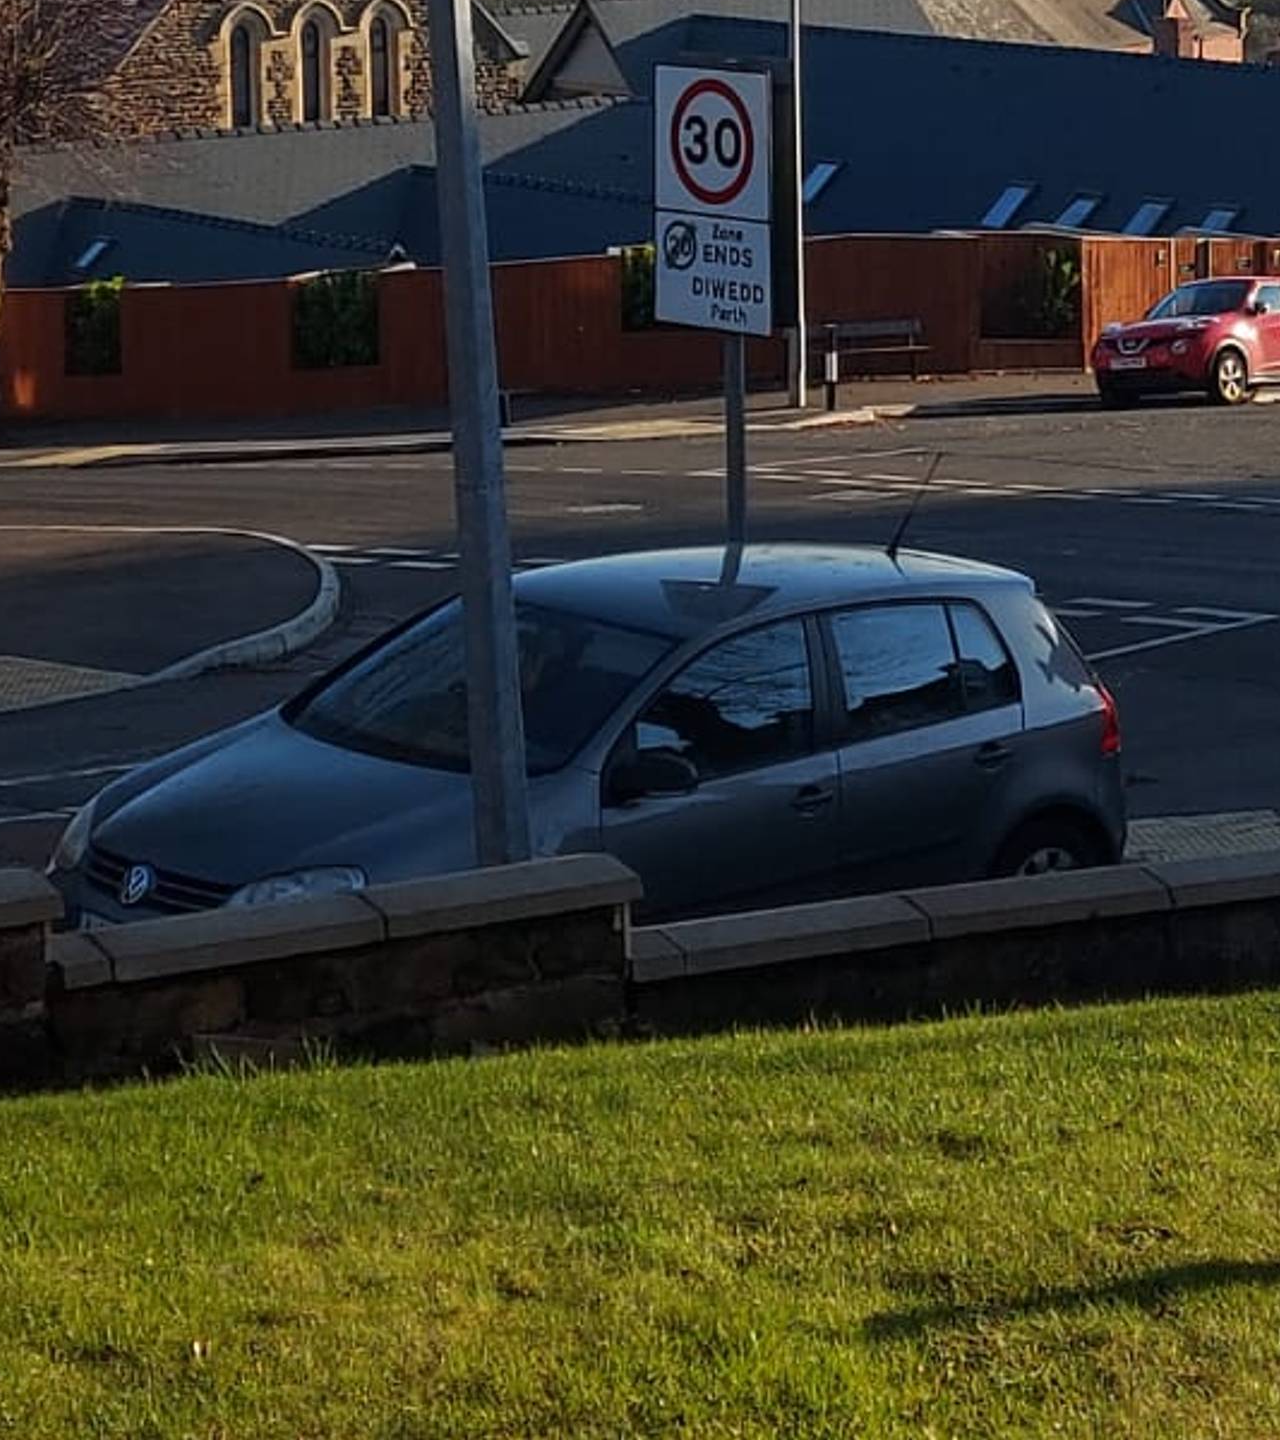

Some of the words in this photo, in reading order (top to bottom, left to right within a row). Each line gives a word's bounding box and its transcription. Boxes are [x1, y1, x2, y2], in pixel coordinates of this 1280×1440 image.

[682, 114, 742, 168] 30
[711, 223, 744, 242] Zone
[702, 243, 753, 269] ENDS
[691, 275, 765, 305] DIWEDD
[710, 303, 748, 327] Parth
